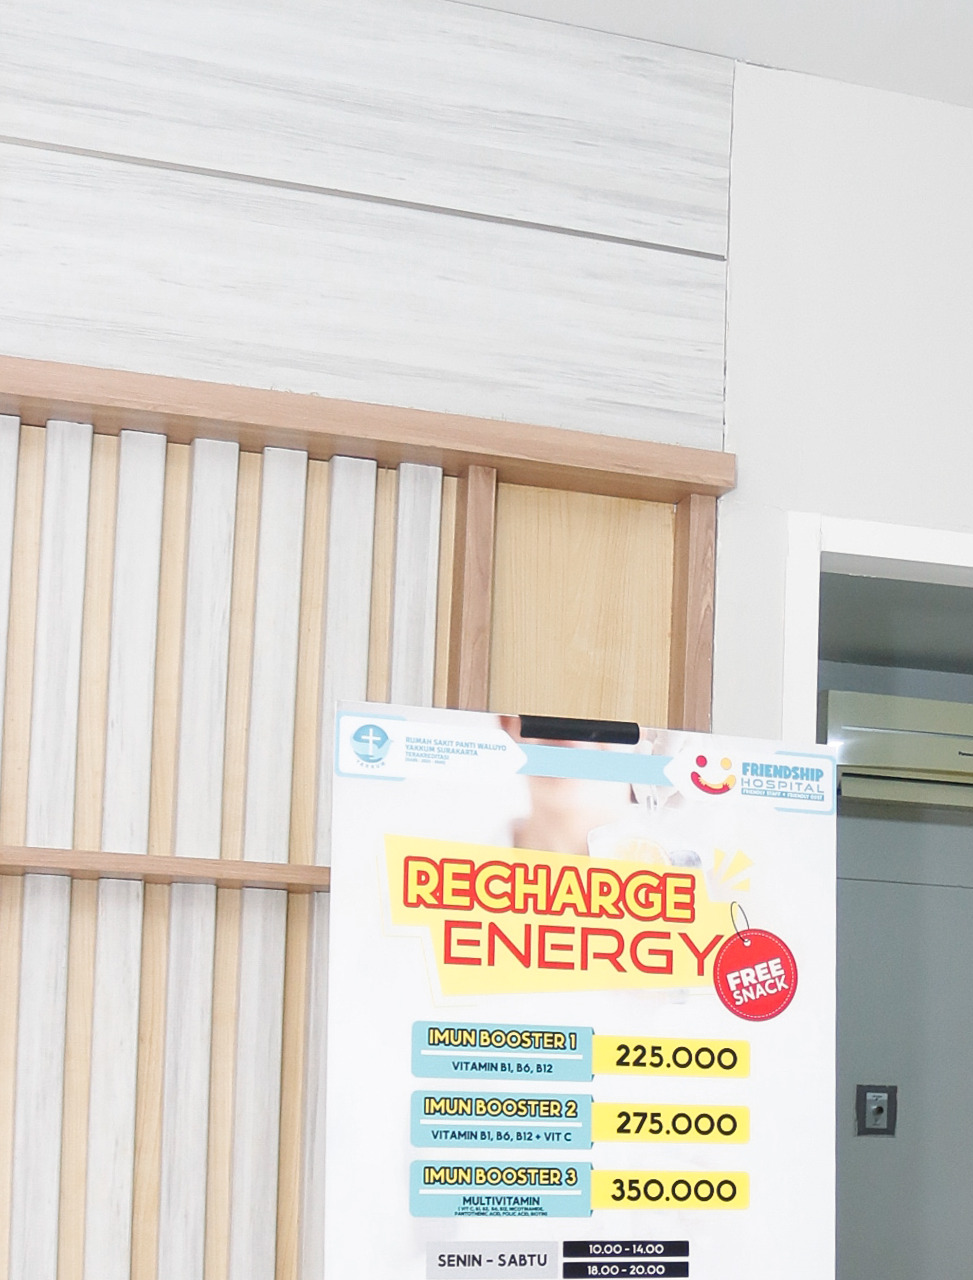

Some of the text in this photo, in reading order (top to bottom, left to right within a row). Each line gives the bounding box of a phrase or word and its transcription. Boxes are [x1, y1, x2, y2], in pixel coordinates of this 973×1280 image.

[405, 736, 507, 752] RUMAH SAKIT PANTI WALUYO
[405, 744, 478, 756] YAKKUM SURAKARTA
[742, 762, 824, 782] FRIENDSHIP
[741, 777, 824, 793] HOSPITAL
[404, 856, 695, 923] RECHARGE
[443, 919, 724, 977] ENERGY
[726, 957, 786, 992] FREE
[732, 975, 789, 1006] SNACK
[428, 1027, 577, 1050] IMUN BOOSTER 1
[615, 1044, 738, 1070] 225.000
[452, 1061, 553, 1074] VITAMIN B1, B6, B12
[424, 1096, 578, 1118] IMUN BOOSTER 2
[616, 1111, 738, 1136] 275.000
[431, 1130, 479, 1141] VITAMIN
[480, 1131, 494, 1142] B1,
[496, 1131, 514, 1142] B6,
[515, 1131, 533, 1141] B12
[543, 1132, 562, 1142] VIT
[564, 1132, 572, 1142] C
[423, 1166, 577, 1186] IMUN BOOSTER 3
[611, 1178, 738, 1202] 350.000
[462, 1196, 540, 1206] MULTIVITAMIN
[588, 1244, 622, 1255] 10.00
[632, 1244, 664, 1255] 14.00
[437, 1254, 483, 1268] SENIN
[498, 1253, 548, 1268] SABTU
[587, 1264, 620, 1276] 18.00
[629, 1264, 666, 1276] 20.00
